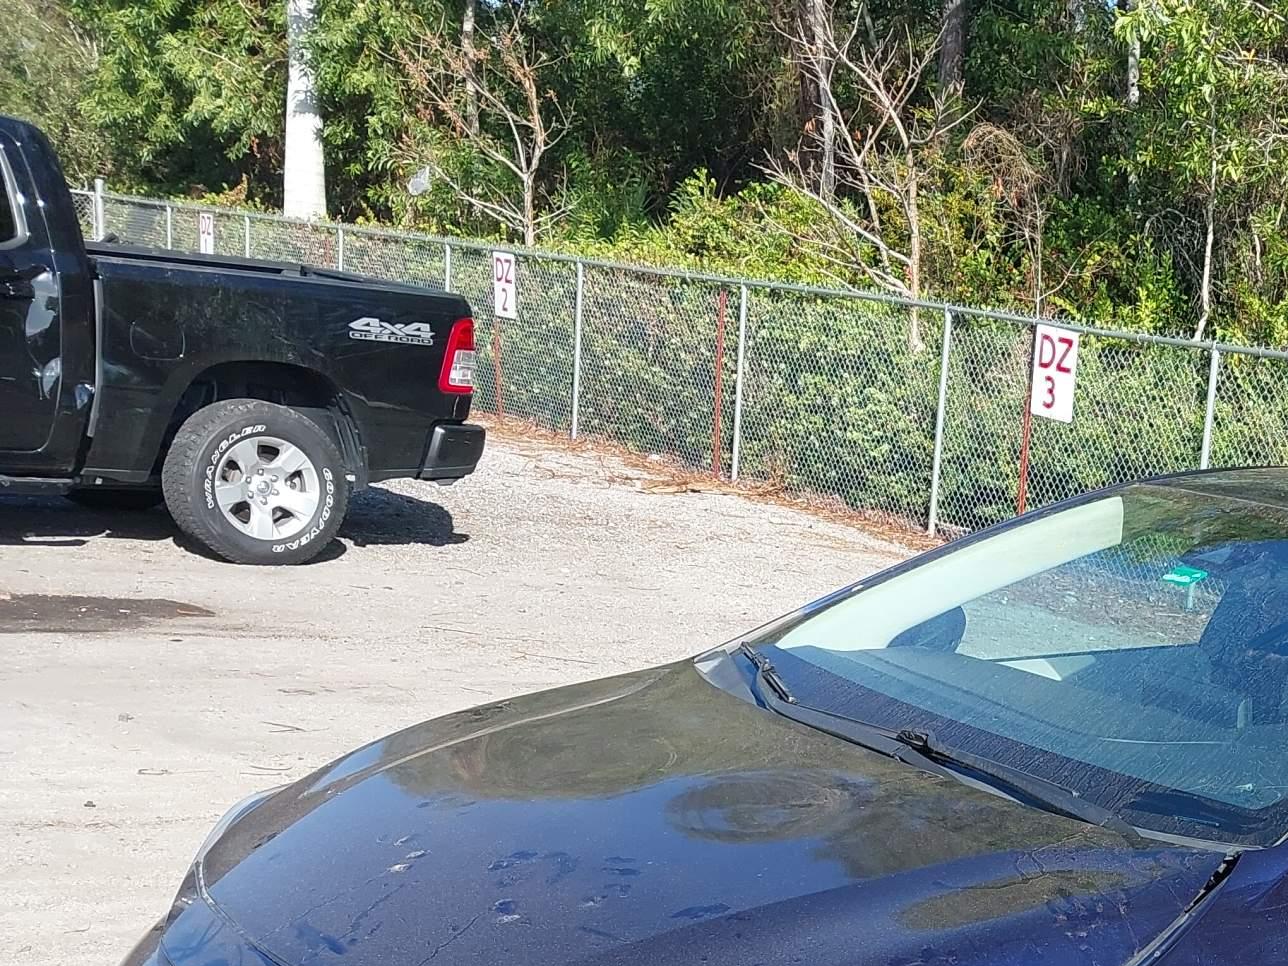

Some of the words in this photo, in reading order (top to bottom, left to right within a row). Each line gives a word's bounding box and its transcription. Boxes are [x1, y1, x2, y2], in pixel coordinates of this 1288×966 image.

[201, 215, 212, 236] DZ
[496, 257, 513, 284] DZ
[501, 287, 508, 312] 2
[1038, 333, 1074, 374] DZ
[1042, 375, 1056, 409] 3
[204, 424, 267, 509] WRANGLER
[271, 467, 334, 553] GOODYEAR
